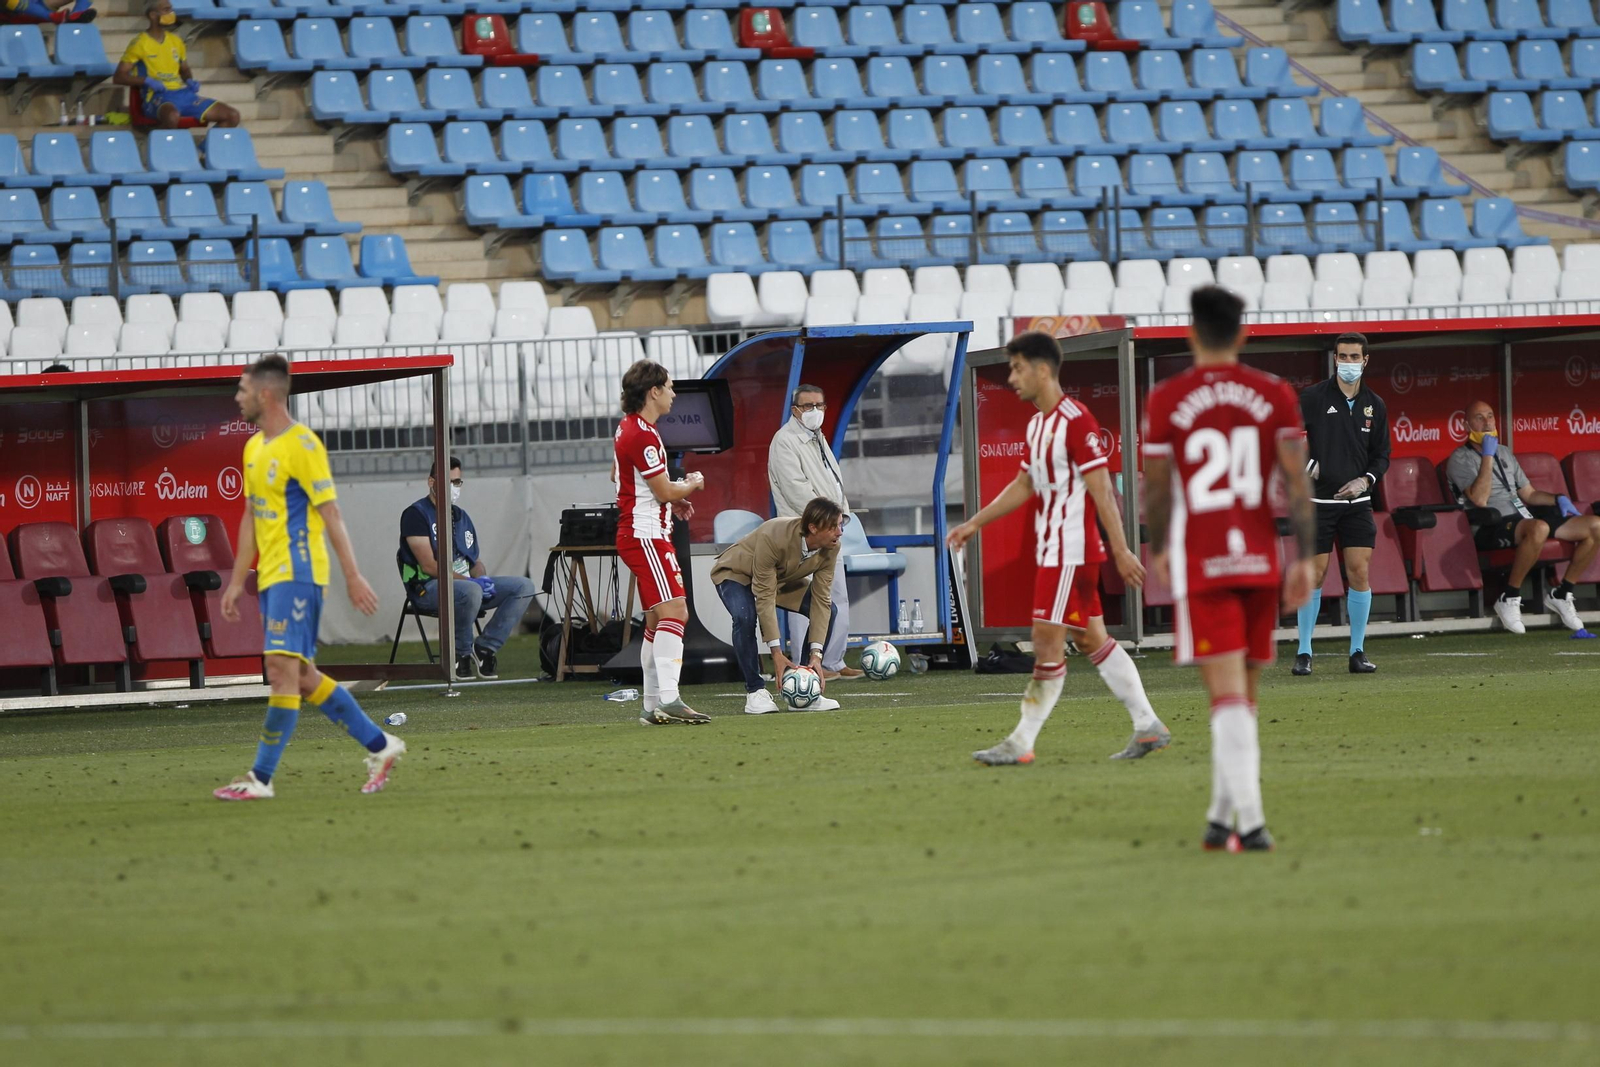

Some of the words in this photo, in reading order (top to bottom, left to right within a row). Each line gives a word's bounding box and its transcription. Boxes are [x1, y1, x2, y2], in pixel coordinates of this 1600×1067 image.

[678, 414, 702, 425] VAR
[1393, 411, 1440, 442] Walem
[1513, 417, 1560, 432] IGNATURE
[1567, 404, 1600, 434] Wale
[182, 430, 206, 441] NAFT
[1184, 425, 1263, 514] 24
[154, 466, 208, 500] Walem
[46, 491, 70, 502] NAFT
